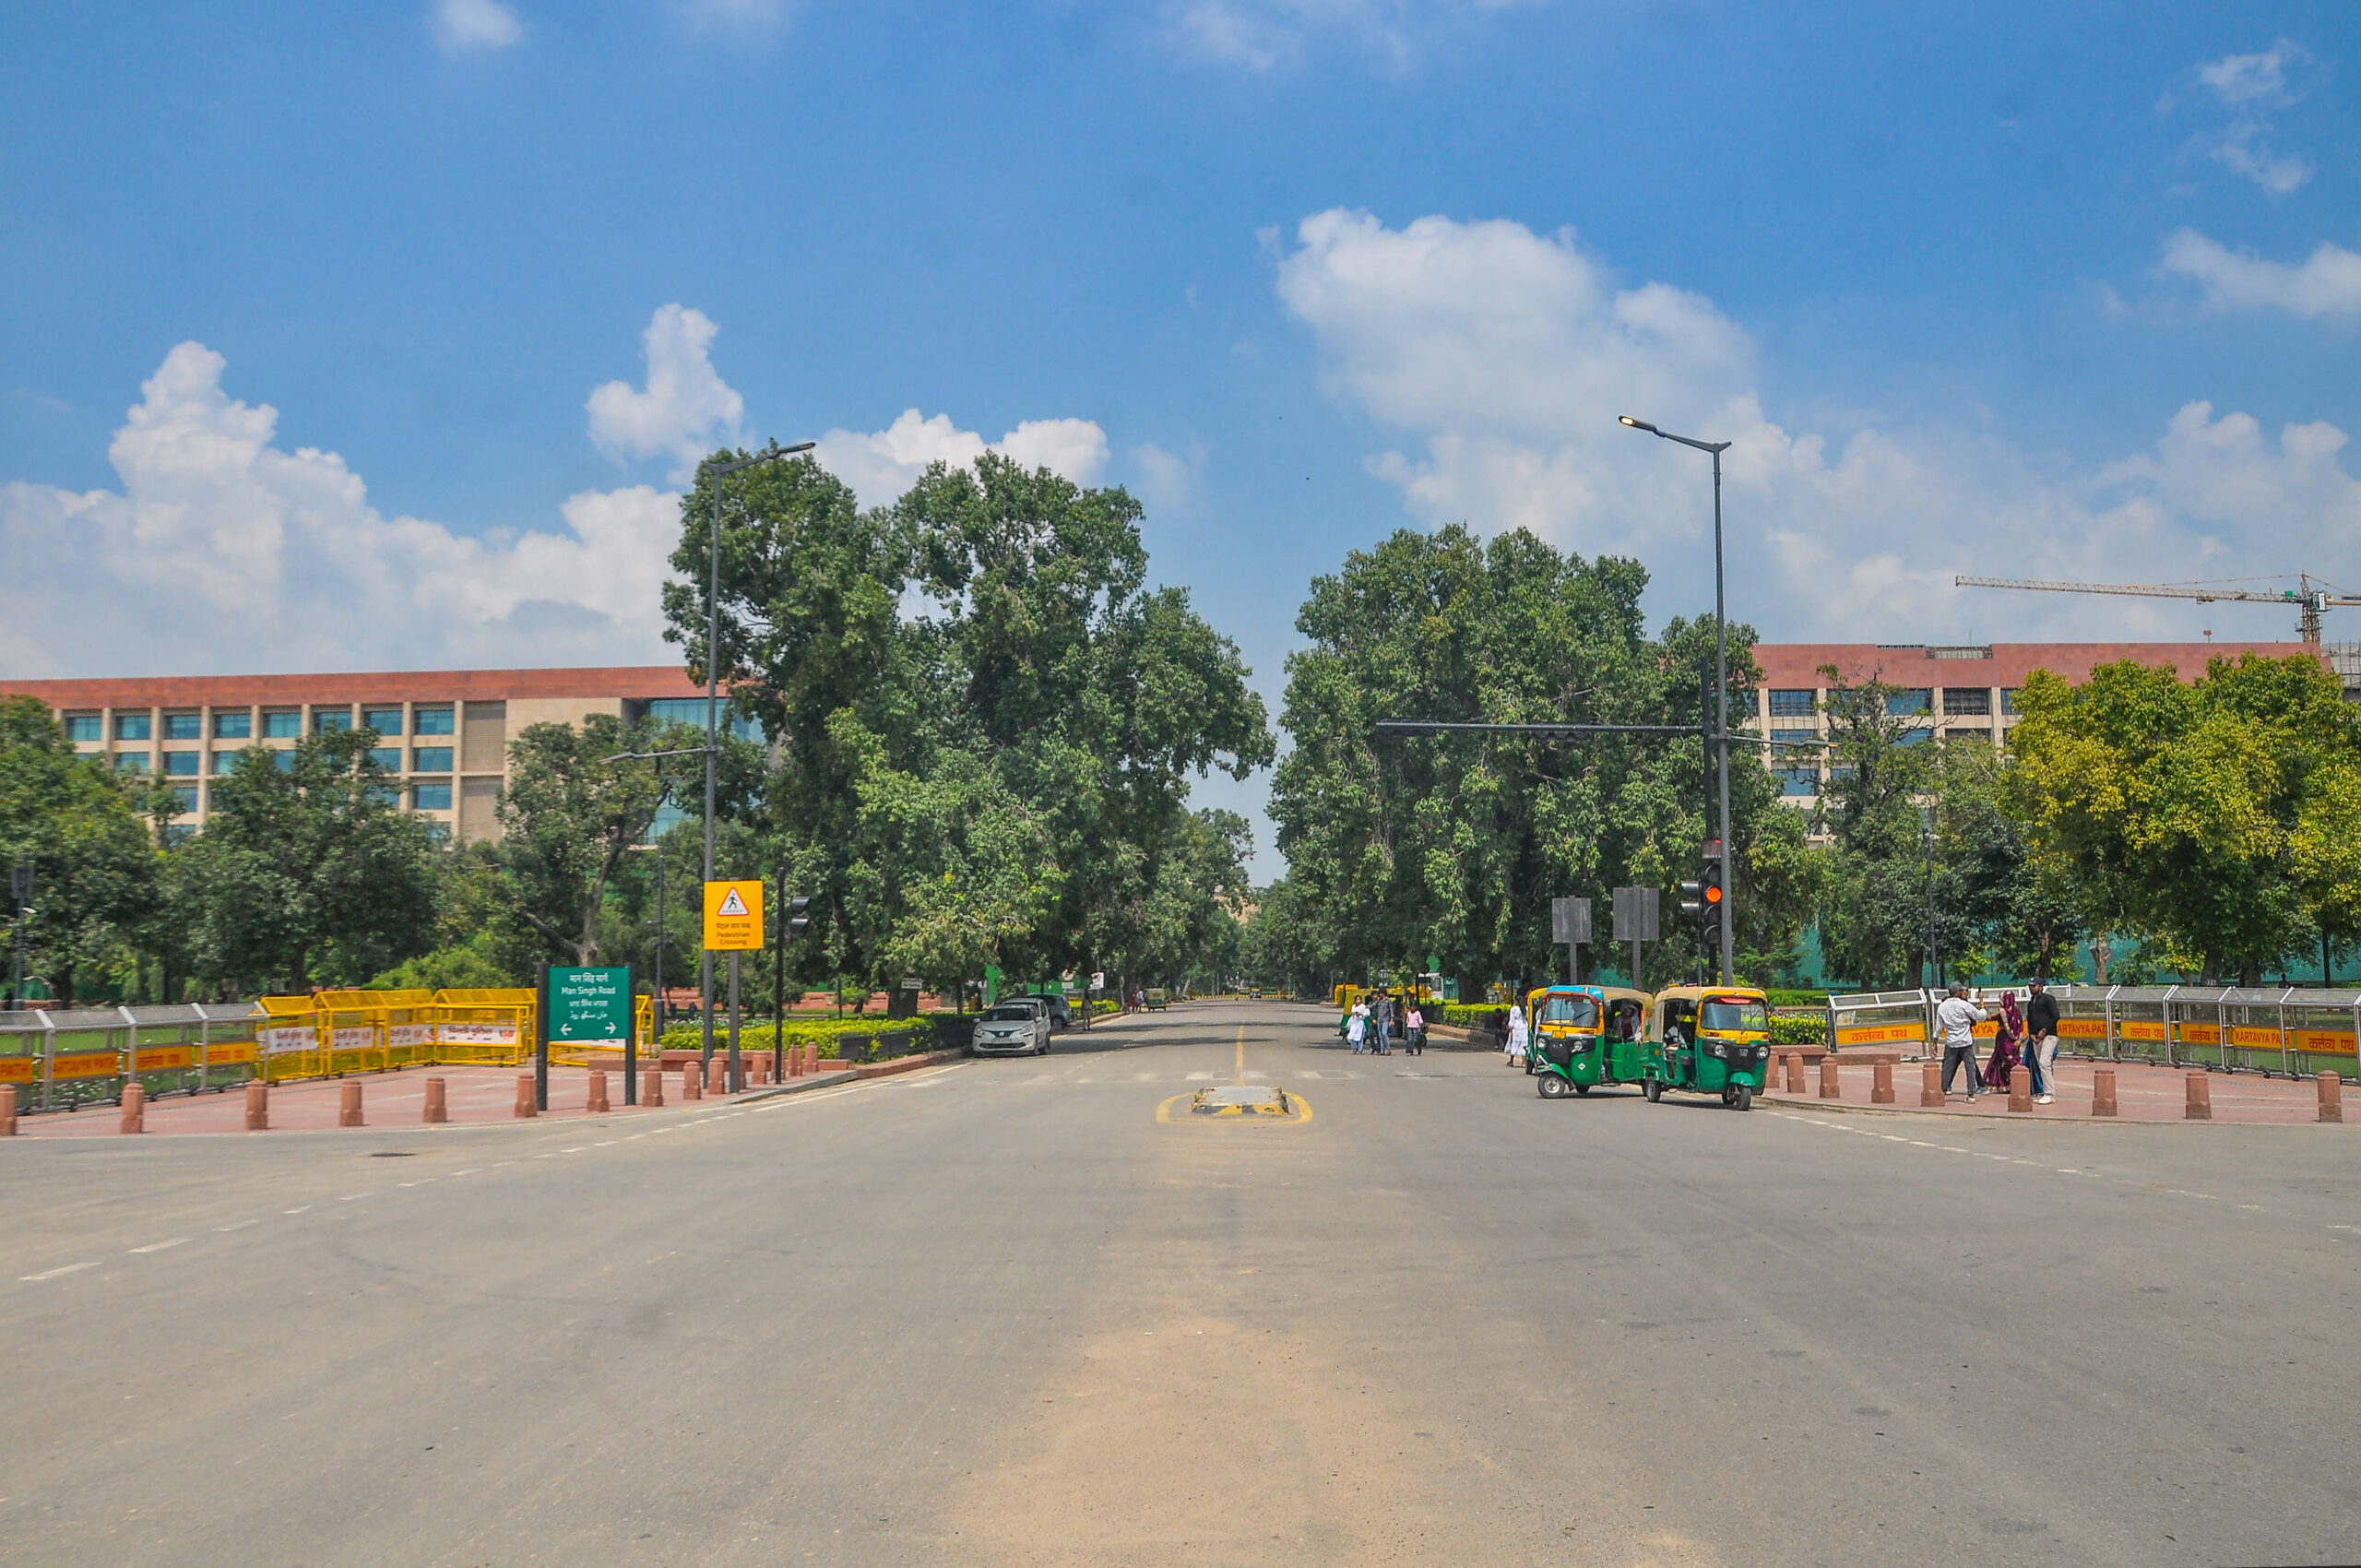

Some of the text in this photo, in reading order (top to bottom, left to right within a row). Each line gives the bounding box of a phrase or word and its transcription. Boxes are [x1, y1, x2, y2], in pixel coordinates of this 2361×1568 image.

[561, 986, 616, 997] Man Singh Road
[1891, 1028, 1907, 1039] पथ
[2058, 1024, 2108, 1034] ARTAVYA PAT
[2236, 1030, 2289, 1045] KARTAVYA PAH
[2341, 1039, 2354, 1051] पथ
